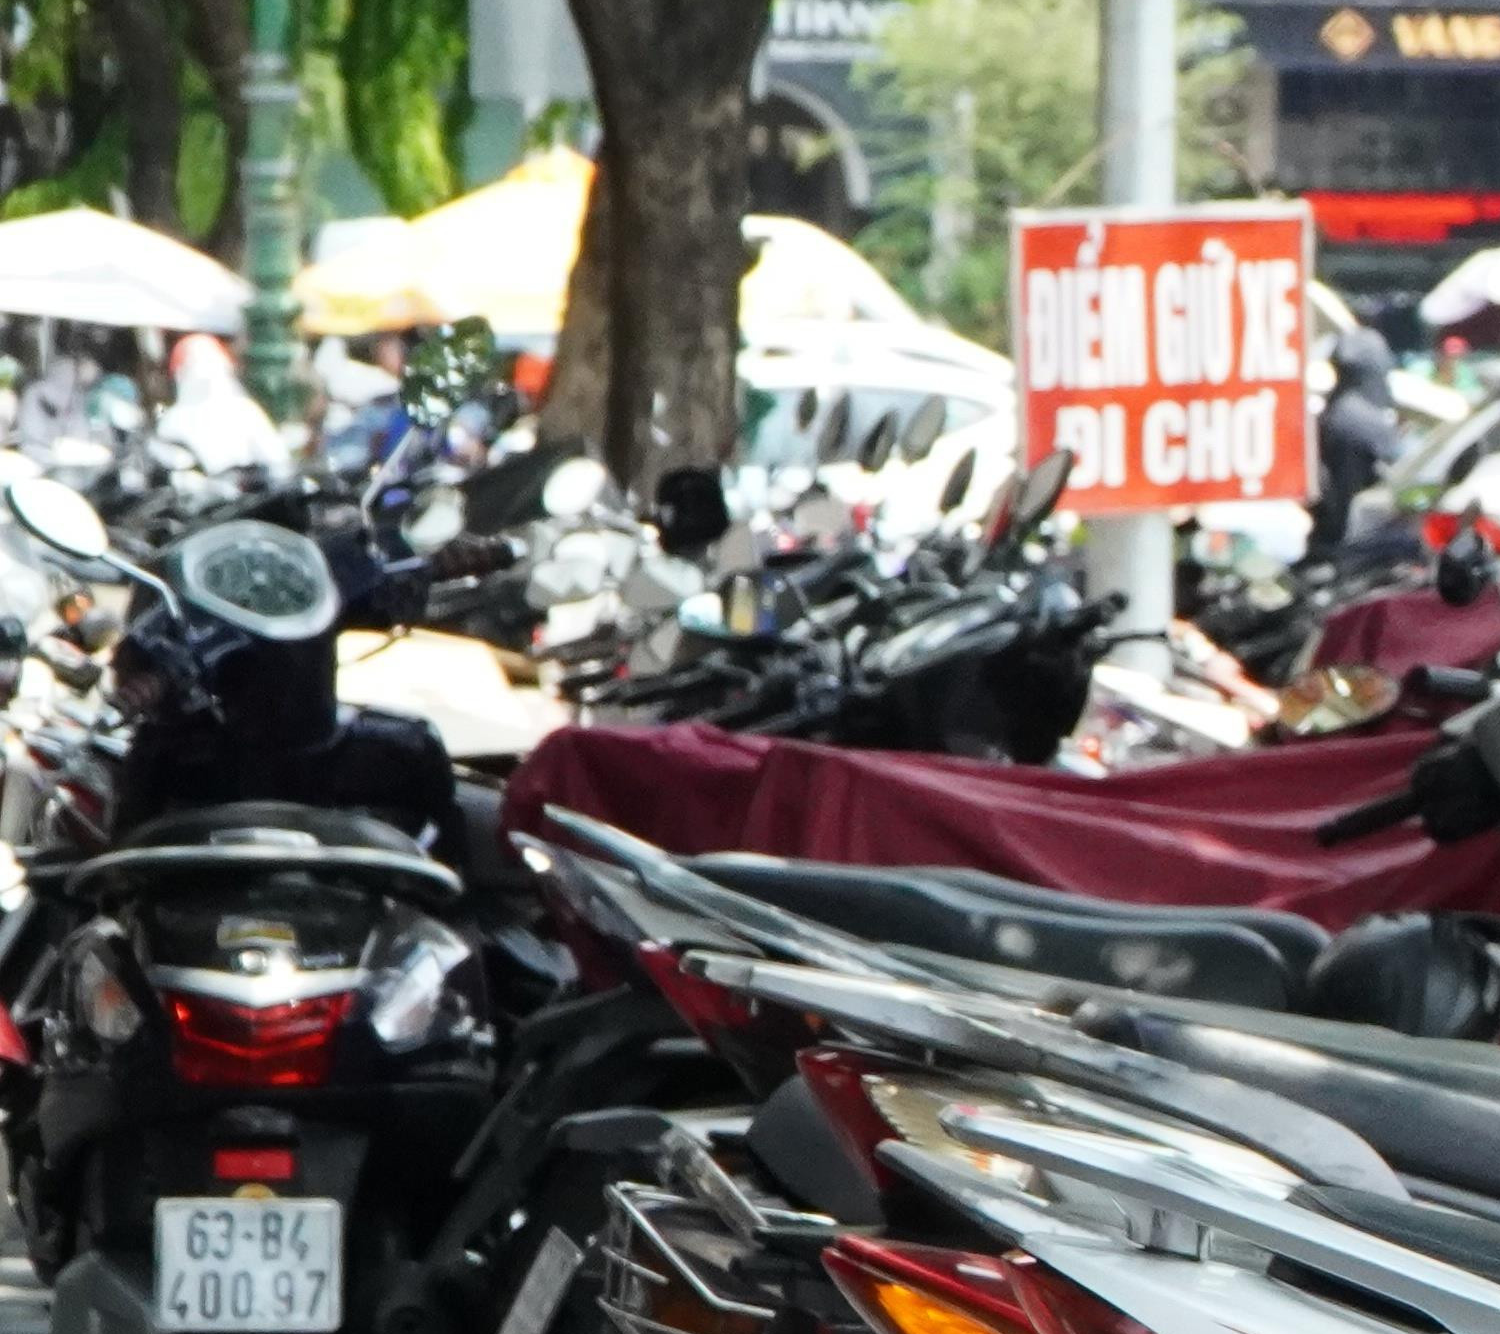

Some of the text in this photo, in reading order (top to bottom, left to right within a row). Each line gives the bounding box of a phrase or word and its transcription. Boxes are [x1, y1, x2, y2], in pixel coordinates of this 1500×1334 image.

[1027, 223, 1148, 389] ĐIỂM
[1237, 258, 1298, 382] XE
[1054, 388, 1277, 496] ĐI CHỢ
